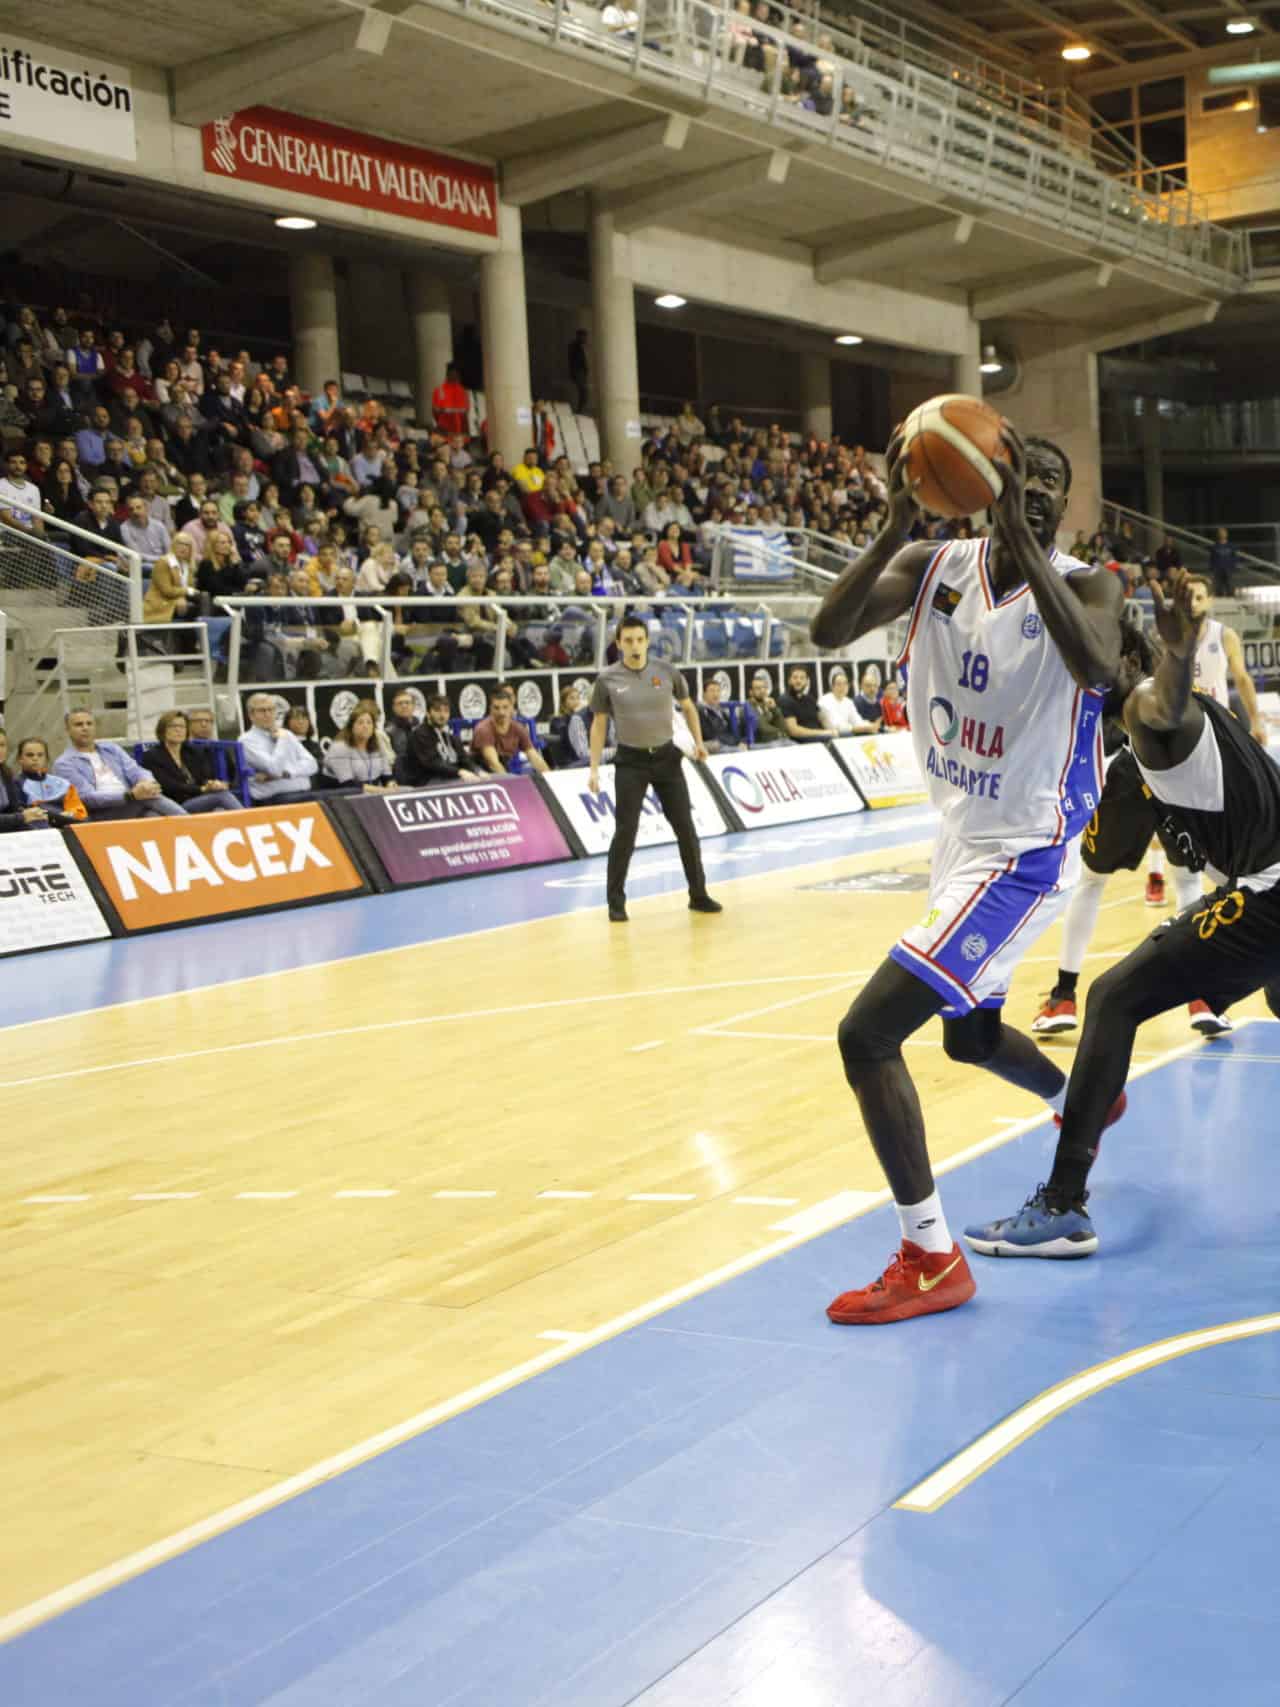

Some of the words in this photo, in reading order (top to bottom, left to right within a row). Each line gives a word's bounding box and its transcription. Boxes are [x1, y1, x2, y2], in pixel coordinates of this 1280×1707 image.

[1, 47, 131, 112] ificación
[238, 125, 372, 192] GENERALITAT
[374, 159, 492, 220] VALENCIANA
[958, 650, 989, 693] 18
[960, 715, 1004, 759] HLA
[755, 769, 802, 804] HLA
[926, 745, 1003, 800] ALICANTE
[396, 791, 507, 823] GAVALDA
[105, 817, 333, 901] NACEX
[38, 891, 76, 904] TECH
